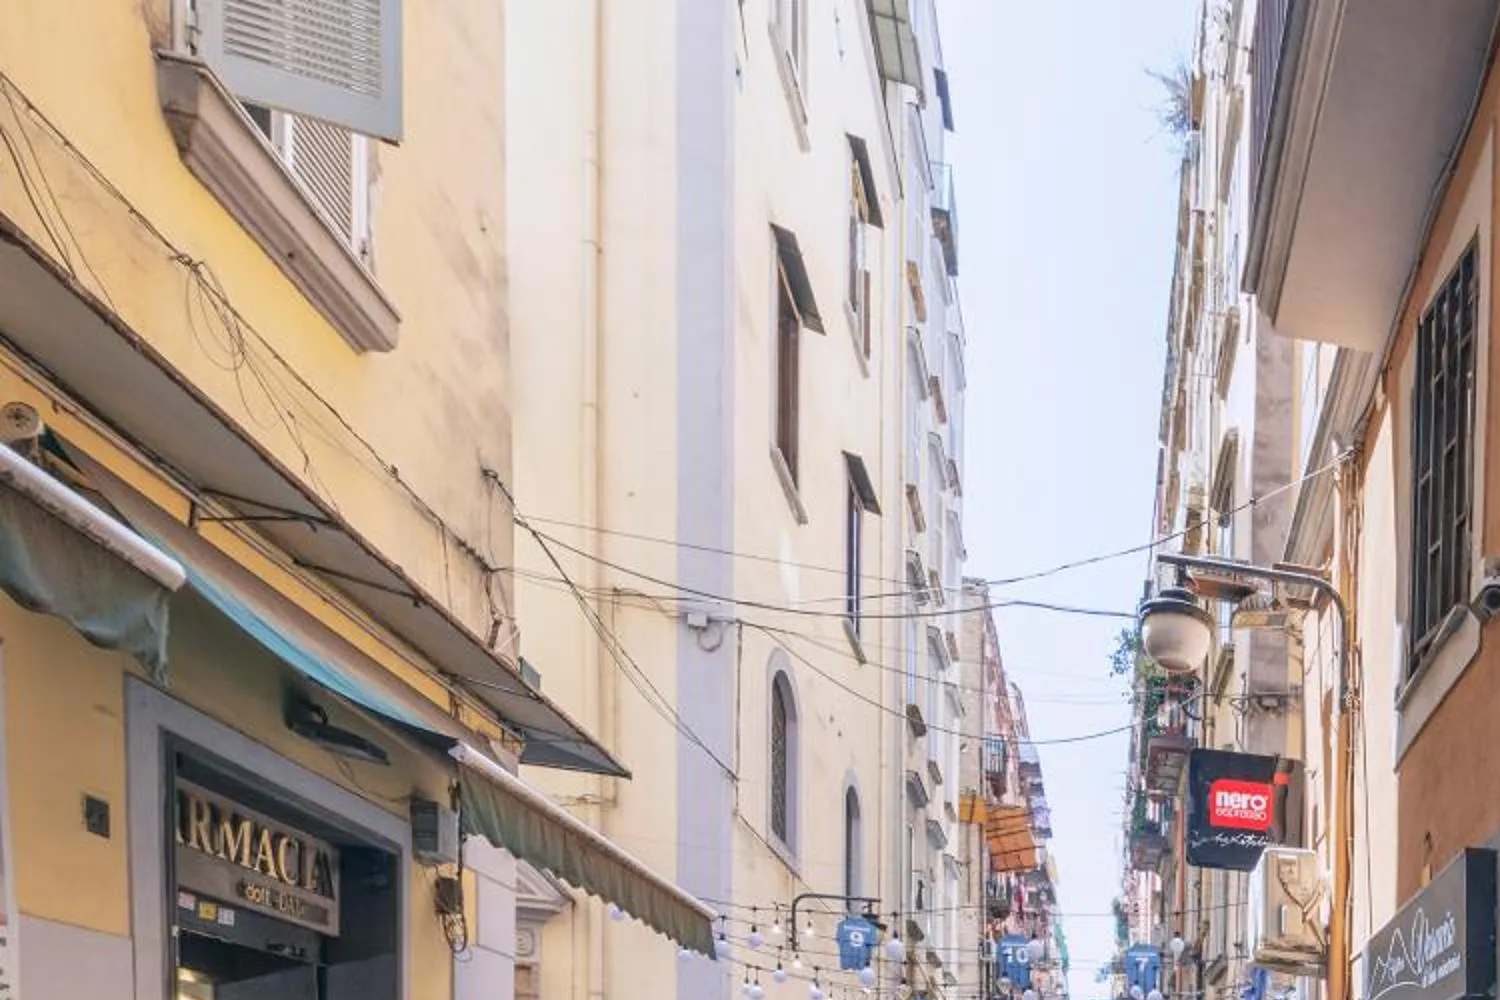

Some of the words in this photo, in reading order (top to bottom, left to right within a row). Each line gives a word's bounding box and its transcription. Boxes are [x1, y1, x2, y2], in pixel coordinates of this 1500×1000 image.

[1215, 791, 1266, 811] nero
[850, 931, 864, 947] 9
[1003, 946, 1028, 964] 10
[1136, 957, 1149, 972] 7
